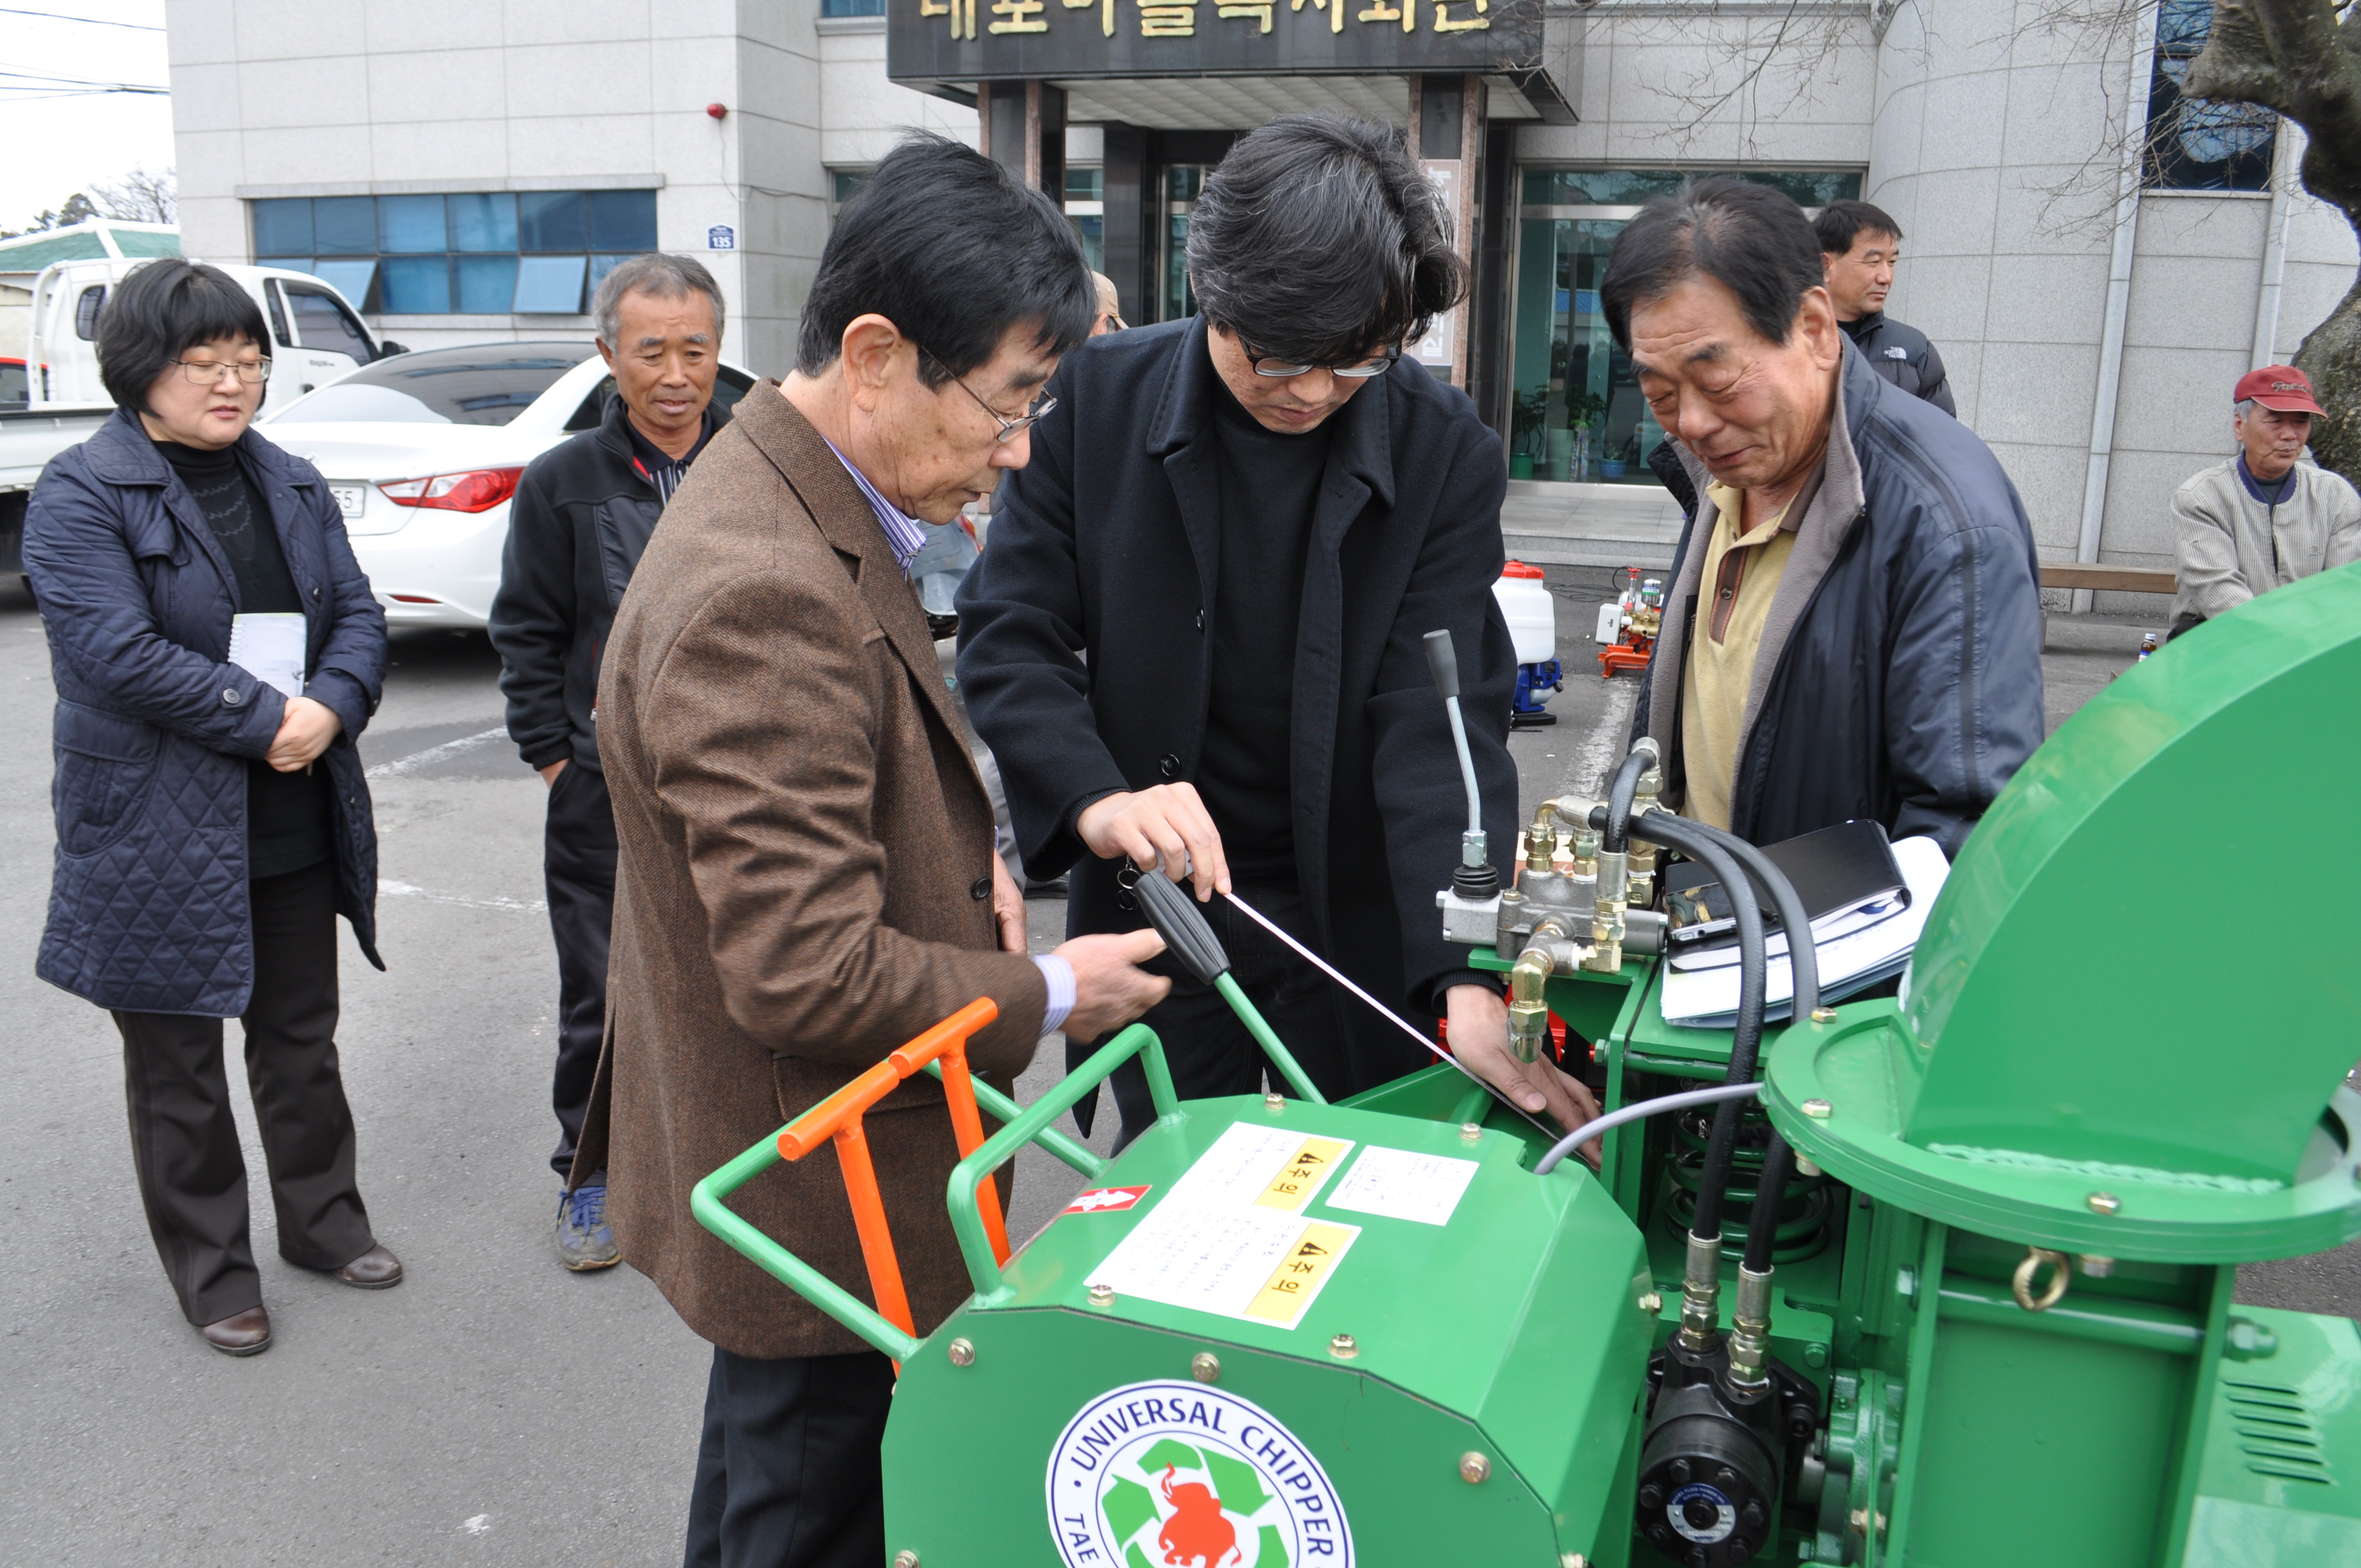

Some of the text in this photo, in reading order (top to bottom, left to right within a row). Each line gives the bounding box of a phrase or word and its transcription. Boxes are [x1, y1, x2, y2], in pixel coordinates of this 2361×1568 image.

[712, 236, 732, 248] 135
[1273, 1168, 1312, 1195] 주의
[1271, 1261, 1314, 1294] 주의
[1070, 1398, 1334, 1556] UNIVERSAL CHIPPER
